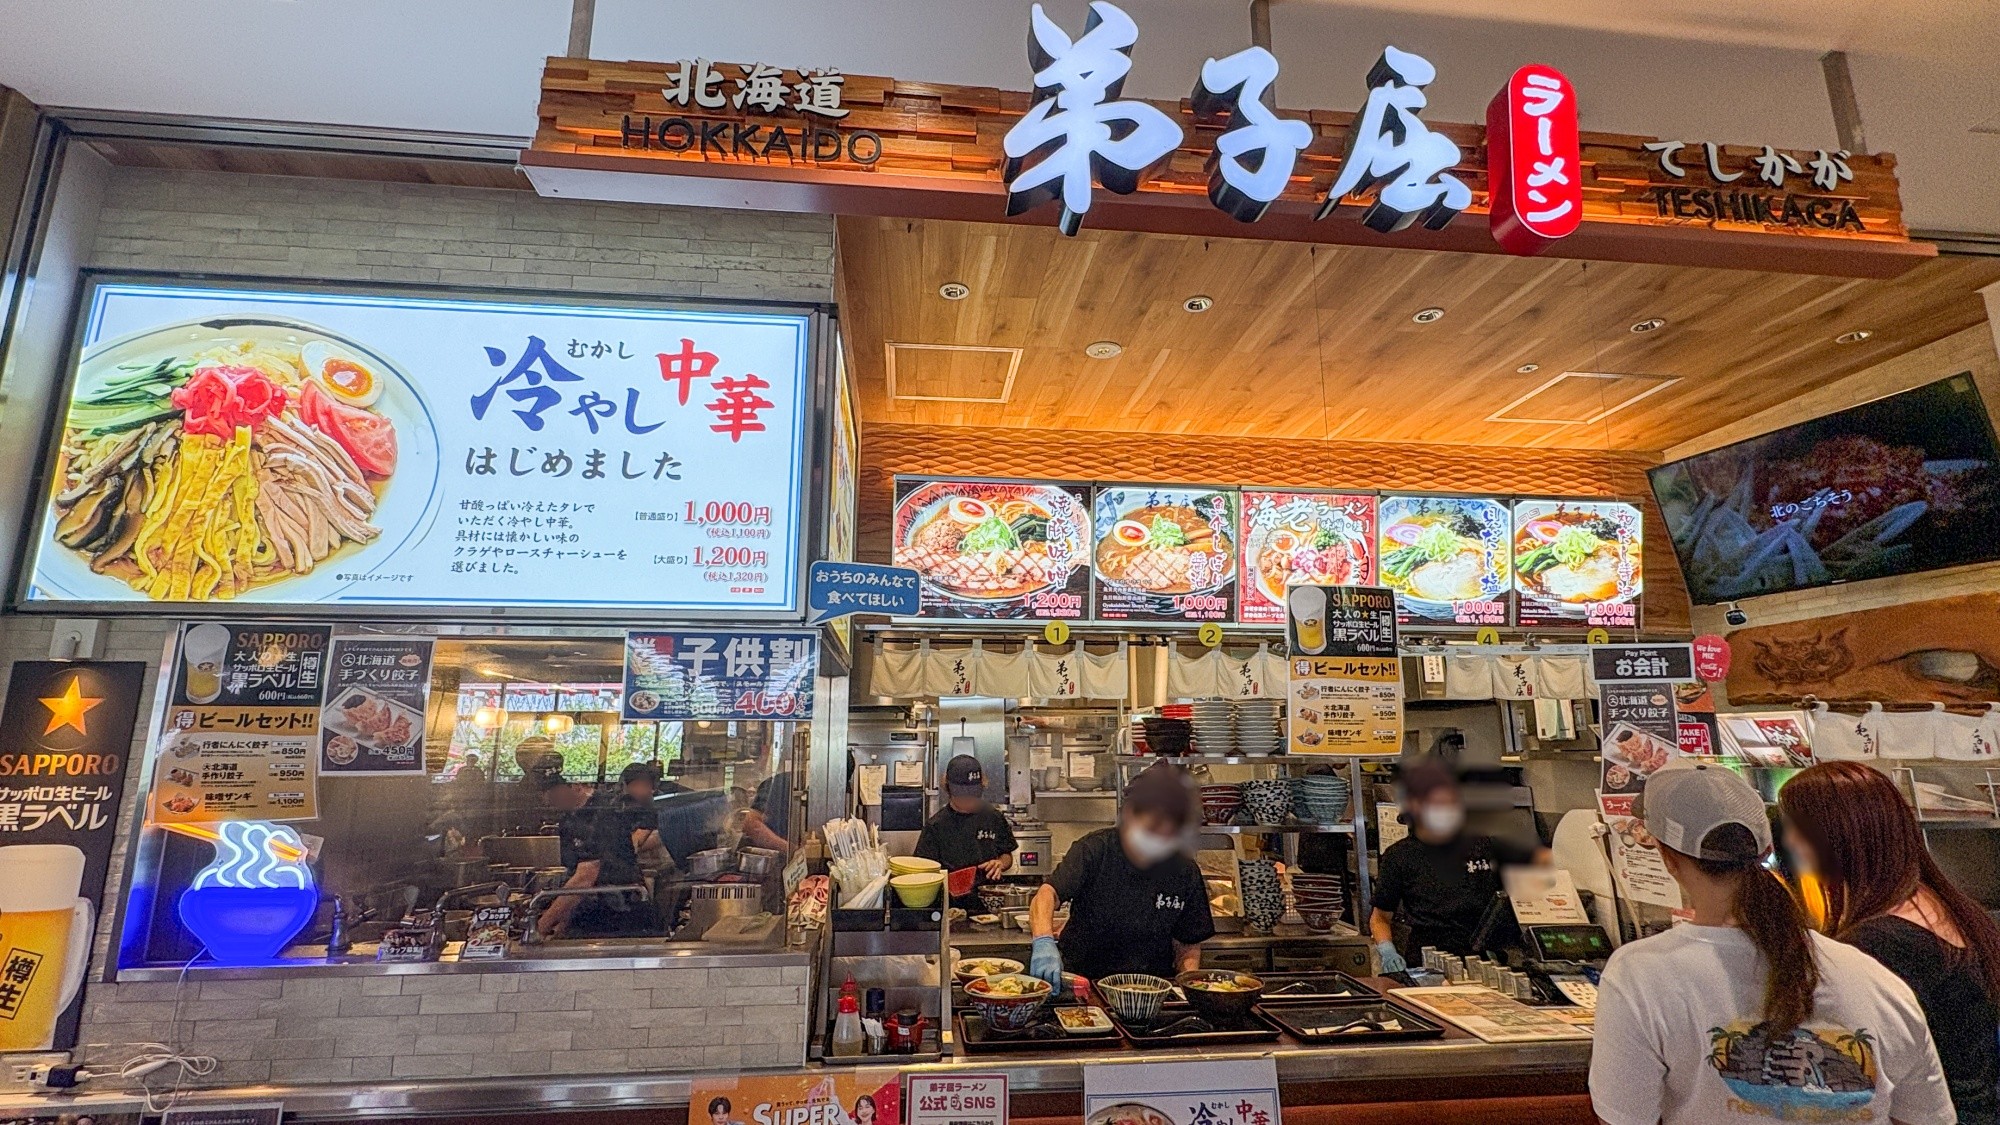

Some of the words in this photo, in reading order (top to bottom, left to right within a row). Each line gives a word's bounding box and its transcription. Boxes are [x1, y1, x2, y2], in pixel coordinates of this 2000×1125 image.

[660, 57, 851, 119] 北海道
[620, 115, 883, 165] HOKKAIDO
[1522, 75, 1573, 222] ラーメン
[1643, 141, 1853, 191] てしかが
[1650, 186, 1867, 232] TESHIKAGA
[567, 339, 634, 360] むかし
[470, 335, 667, 435] 冷やし
[655, 338, 775, 443] 中華
[466, 446, 682, 480] はじめました
[459, 499, 595, 514] 甘酸っぱい冷えたタレで
[1770, 488, 1852, 518] 北のごちそう
[683, 500, 771, 525] 1,000円
[1247, 495, 1313, 532] 海老
[1316, 501, 1369, 515] ラーメン
[458, 516, 574, 529] いただく冷やし中華。
[455, 530, 580, 544] 具材には懐かしい味の
[453, 546, 628, 560] クラゲやロースチャーシューを
[693, 545, 768, 567] 1,200円
[451, 561, 519, 575] 選びました。
[815, 569, 917, 589] おうちのみんなで
[826, 590, 905, 608] 食べてほしい
[1022, 593, 1082, 609] 1,200円
[1172, 595, 1228, 610] 1,000円
[1332, 594, 1391, 609] SAPPORO
[1452, 600, 1504, 614] 1,000円
[1584, 602, 1635, 617] 1,000円
[1332, 620, 1379, 628] サッポロ生ビール
[1381, 613, 1392, 640] 樽生
[237, 632, 323, 649] SAPPORO
[1053, 627, 1060, 640] 1
[1205, 629, 1216, 643] 2
[1332, 628, 1380, 642] 黒ラベル
[1483, 634, 1493, 645] 4
[1356, 643, 1376, 653] 600円
[356, 655, 396, 666] 北海道
[677, 637, 812, 677] 子供割
[300, 656, 318, 684] 樽生
[1295, 660, 1311, 676] 得
[1314, 661, 1397, 676] ビールセット!!
[1615, 657, 1669, 677] お会計
[231, 672, 296, 688] 黒ラベル
[338, 669, 419, 681] 手づくり餃子
[258, 690, 286, 701] 600円
[1320, 685, 1370, 693] 行者にんにく餃子
[1619, 696, 1648, 705] 北海道
[176, 711, 196, 729] 得
[199, 711, 313, 730] ビールセット!!
[1323, 711, 1356, 719] 手作り餃子
[1608, 708, 1669, 719] 手づくり餃子
[1678, 728, 1701, 737] TAKE
[202, 740, 269, 749] 行者にんにく餃子
[1679, 737, 1697, 745] OUT
[382, 746, 414, 756] 450円
[0, 754, 120, 776] SAPPORO
[211, 763, 238, 771] 北海道
[929, 1082, 987, 1092] 弟子屈ラーメン
[919, 1095, 948, 1111] 公式
[964, 1096, 996, 1109] SNS
[753, 1102, 840, 1125] SUPER
